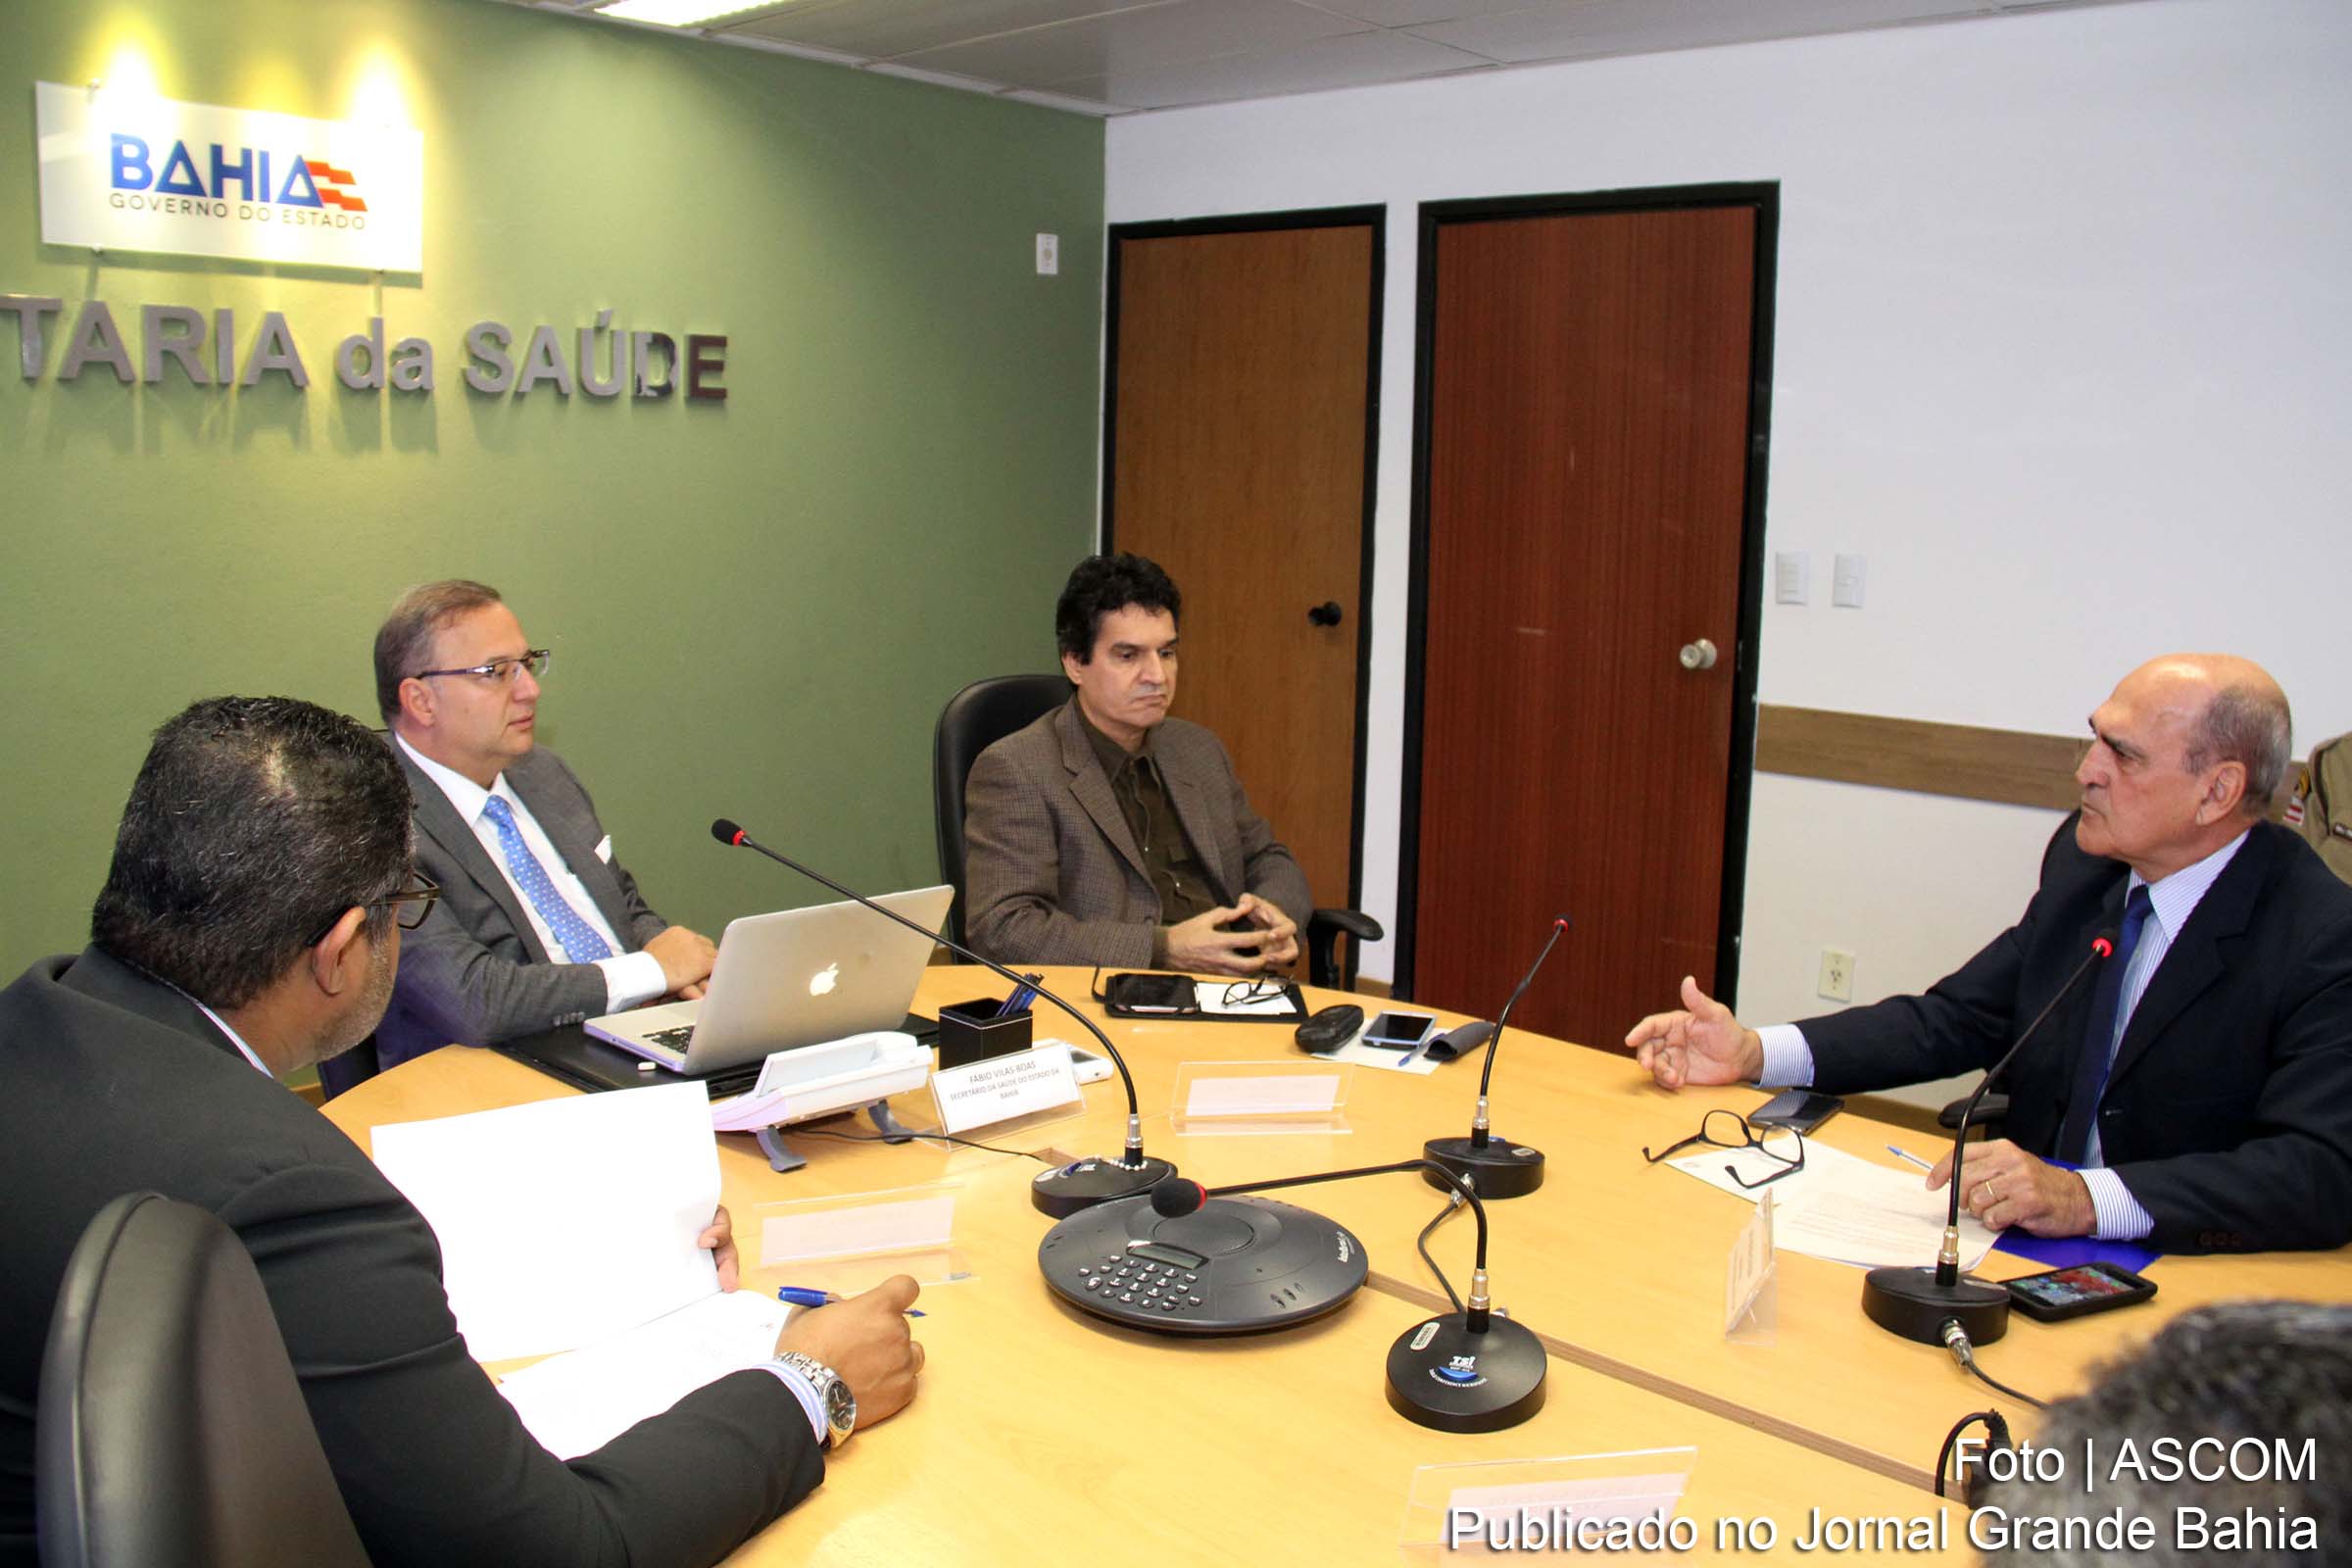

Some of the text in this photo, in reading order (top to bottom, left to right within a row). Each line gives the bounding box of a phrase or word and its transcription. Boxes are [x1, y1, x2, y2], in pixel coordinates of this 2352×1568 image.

[110, 132, 324, 209] BAHIA
[109, 192, 366, 230] GOVERNO DO ESTADO
[0, 293, 727, 399] TARIA da SAÚDE
[994, 1060, 1037, 1078] VILAS-BOAS
